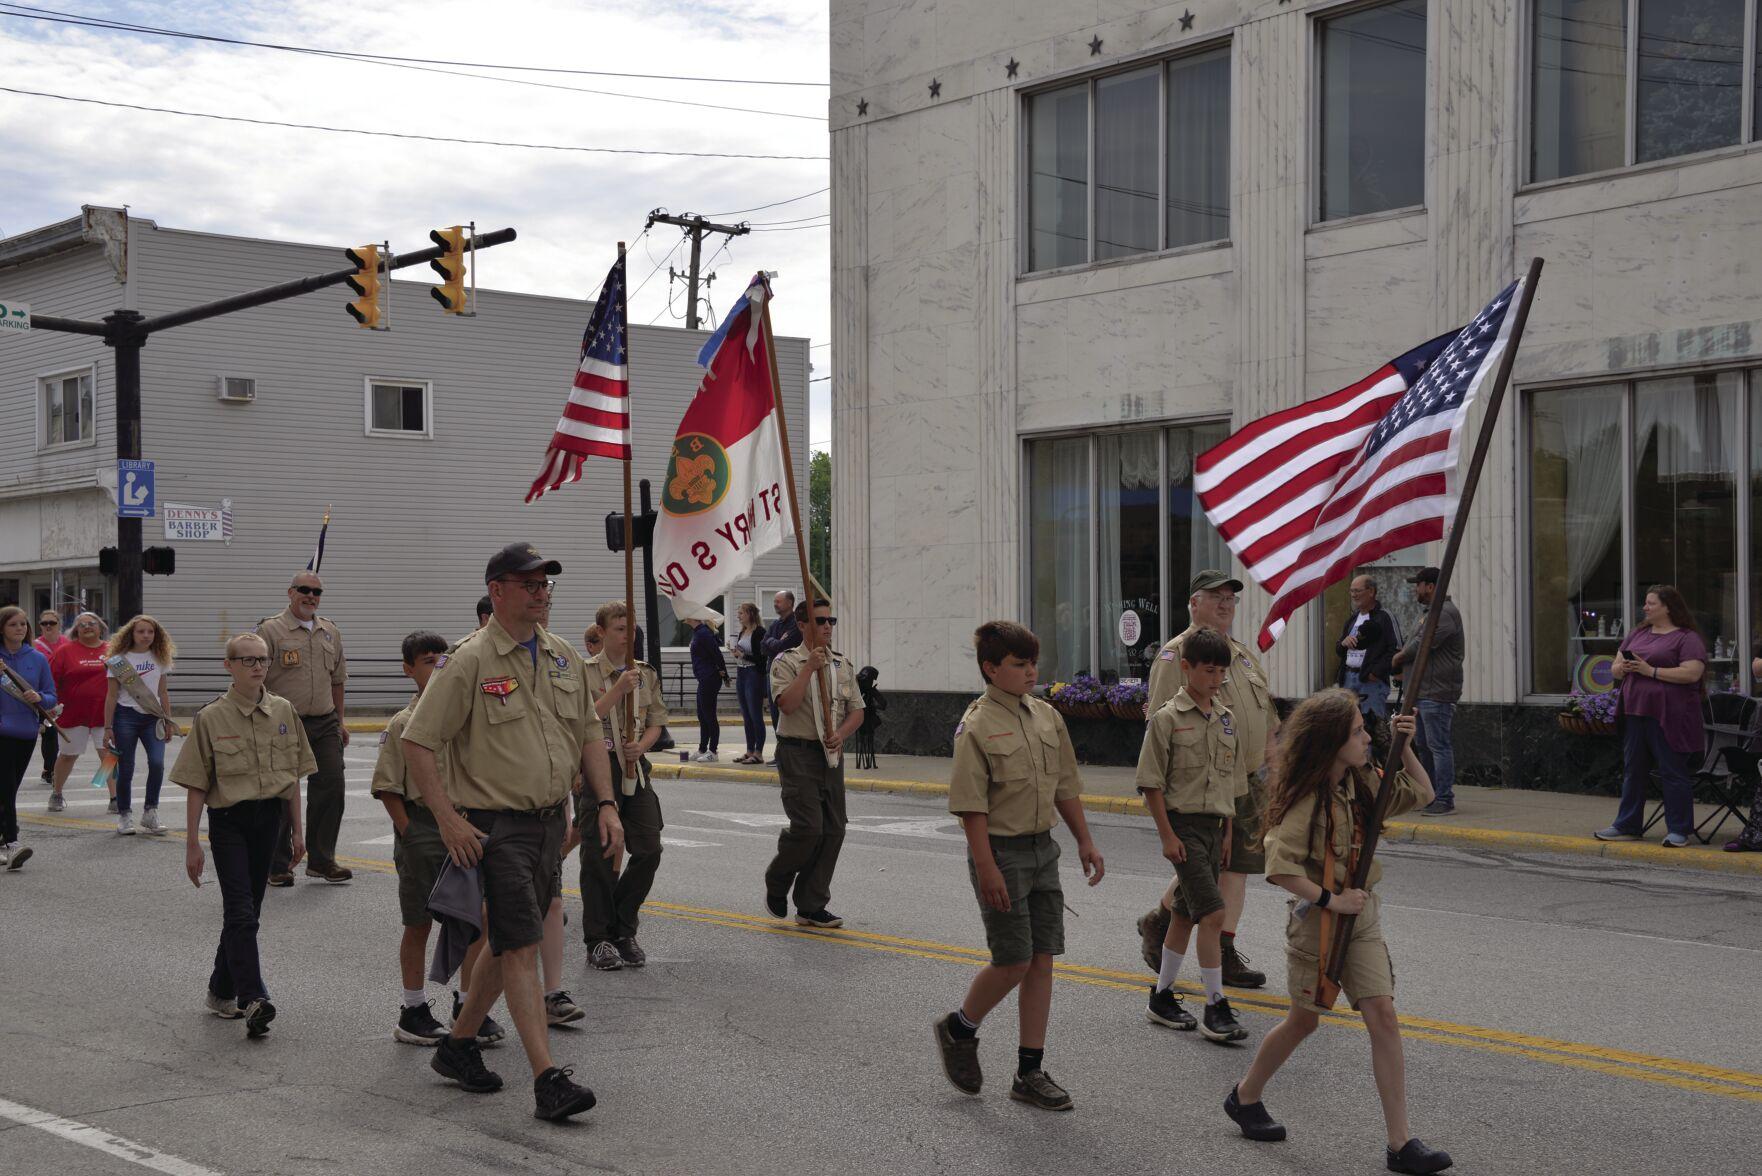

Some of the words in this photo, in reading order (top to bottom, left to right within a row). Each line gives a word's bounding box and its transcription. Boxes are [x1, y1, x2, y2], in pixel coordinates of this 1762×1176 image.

[122, 460, 151, 470] LIBRARY
[167, 509, 218, 519] DENNY'S
[168, 520, 217, 531] BARBER
[176, 529, 210, 539] SHOP
[1138, 597, 1158, 615] WELL
[136, 661, 155, 671] nike
